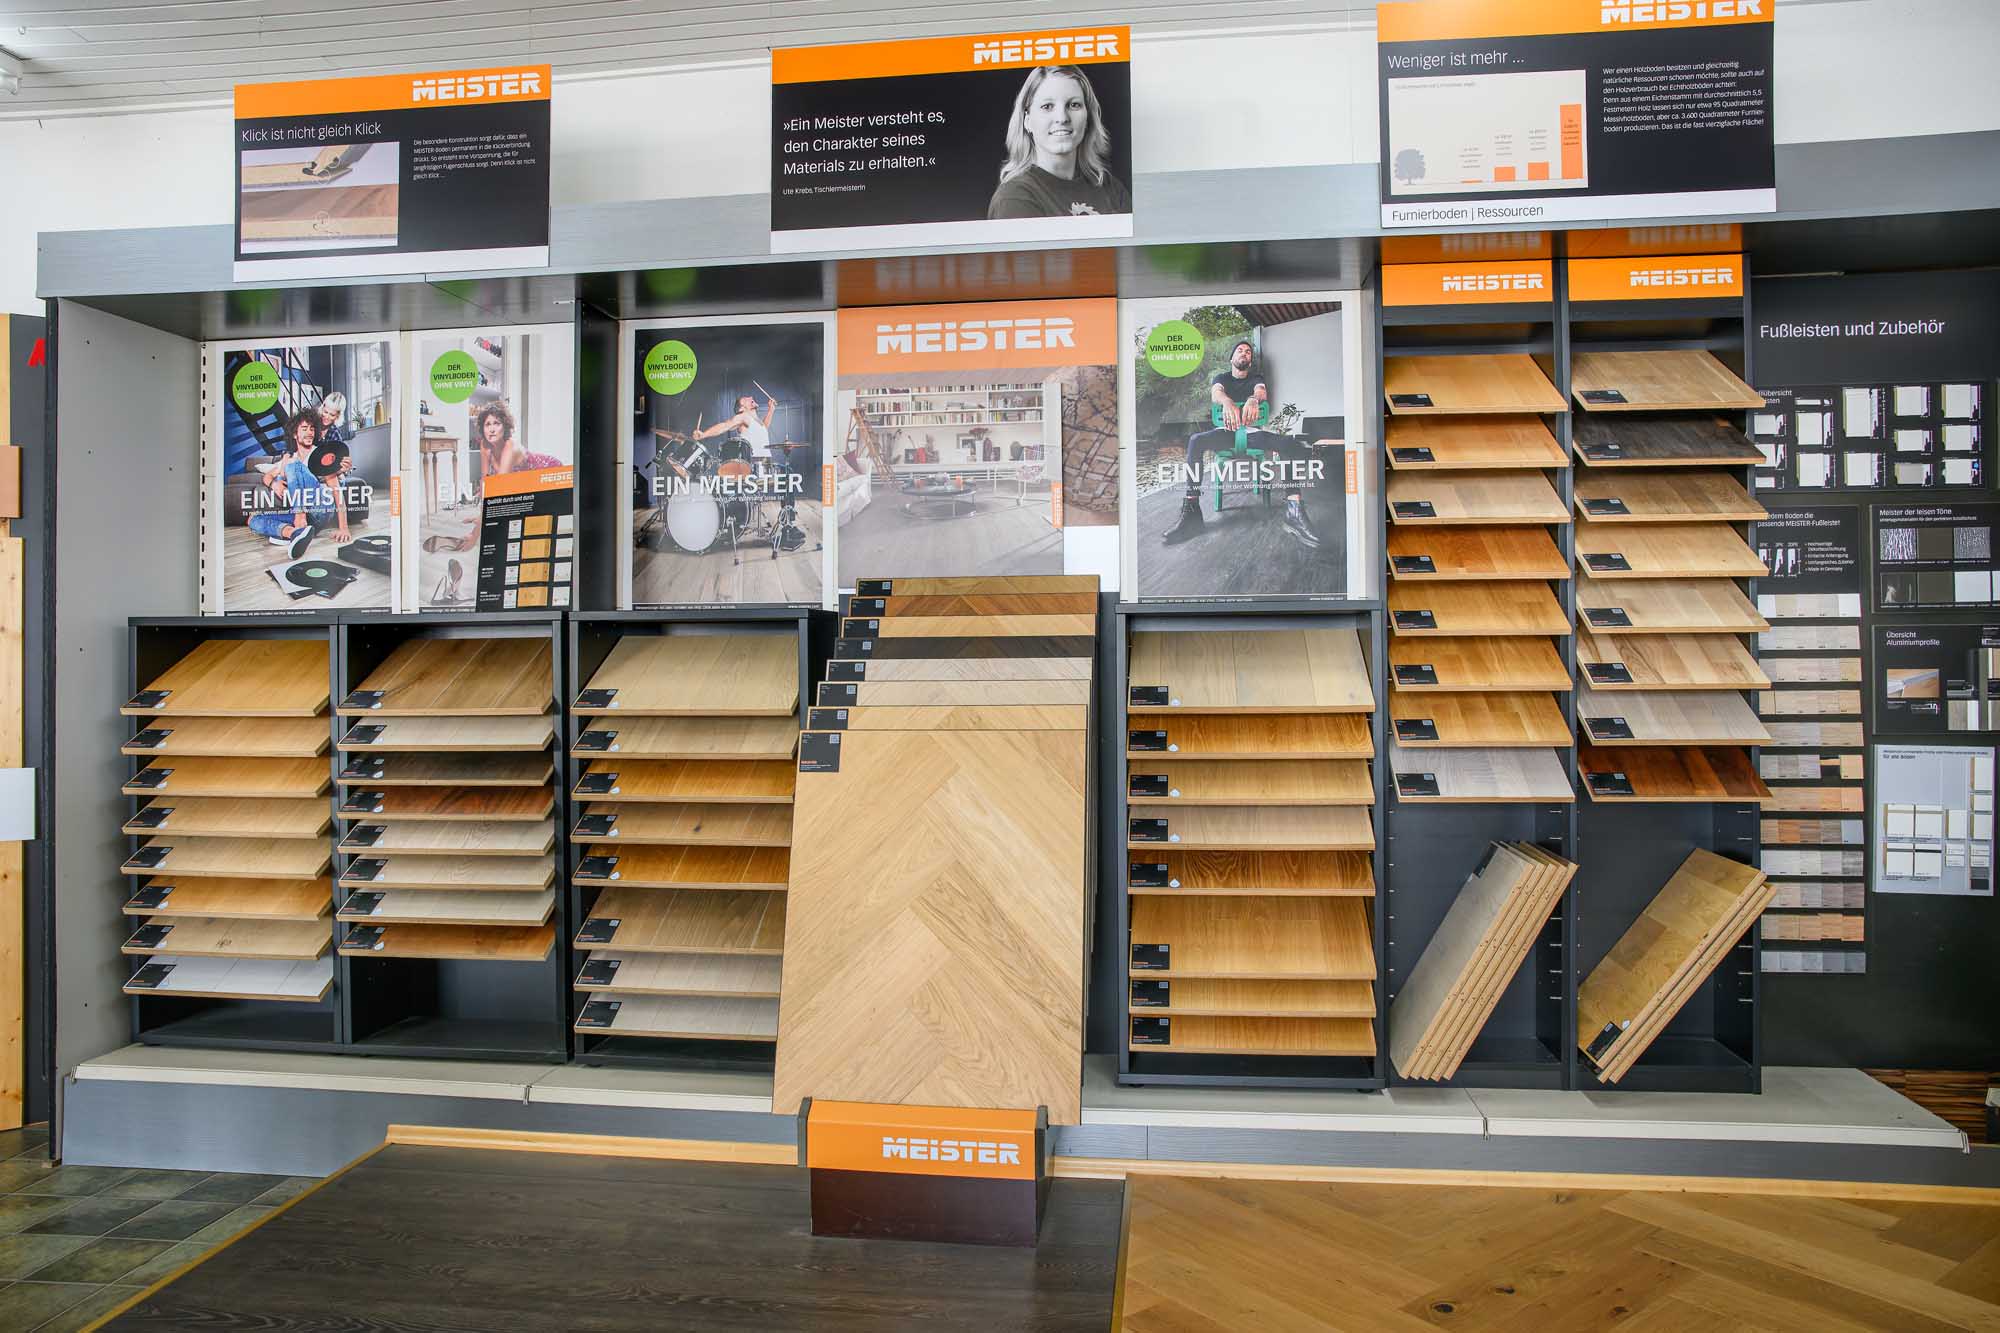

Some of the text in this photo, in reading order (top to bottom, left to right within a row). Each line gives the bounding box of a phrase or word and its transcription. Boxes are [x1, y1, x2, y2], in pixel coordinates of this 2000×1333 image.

[1600, 0, 1762, 24] MEISTER
[973, 34, 1120, 64] MEISTER
[1388, 54, 1446, 70] Weniger
[1451, 52, 1466, 66] ist
[1470, 50, 1508, 64] mehr
[1634, 65, 1665, 73] Holzboden
[1706, 61, 1739, 70] gleichzeitig
[412, 73, 541, 102] MEISTER
[1616, 85, 1658, 93] Holzverbrauch
[1652, 93, 1691, 101] Eichenstamm
[1704, 90, 1751, 98] durchschnittlich
[784, 111, 945, 131] »Ein Meister versteht es,
[1699, 110, 1740, 118] Quadratmeter
[242, 122, 381, 141] Klick ist nicht gleich Klick
[1624, 123, 1660, 132] produzieren.
[1705, 119, 1740, 128] vierzigfache
[784, 134, 925, 153] den Charakter seines
[784, 156, 935, 175] Materials zu erhalten.«
[814, 184, 865, 193] Tischlermeisterin
[1392, 206, 1544, 221] Furnierboden Ressourcen
[1442, 273, 1544, 292] MEISTER
[1630, 268, 1734, 287] MEISTER
[876, 318, 1075, 354] MEISTER
[1760, 320, 1945, 338] Fußleisten und Zubehör
[540, 471, 573, 483] MEISTE
[1158, 462, 1200, 483] EIN
[1210, 460, 1325, 482] MEISTER
[652, 476, 690, 496] EIN
[700, 474, 803, 494] MEISTER
[241, 490, 274, 509] EIN
[283, 486, 374, 507] MEISTER
[882, 1136, 1020, 1165] MEISTER
